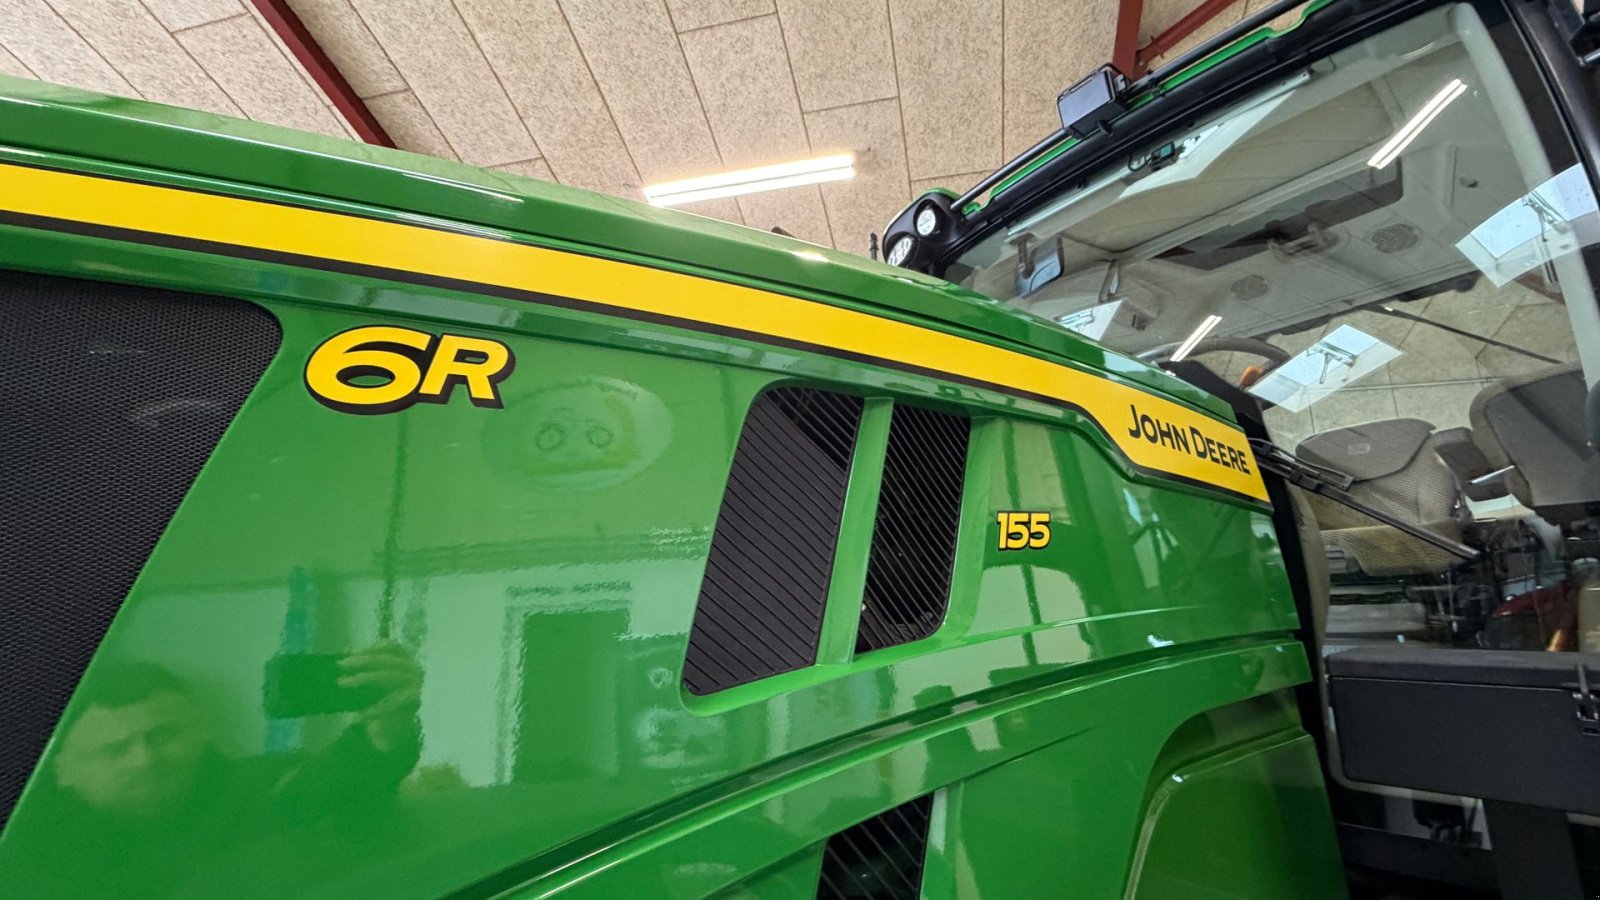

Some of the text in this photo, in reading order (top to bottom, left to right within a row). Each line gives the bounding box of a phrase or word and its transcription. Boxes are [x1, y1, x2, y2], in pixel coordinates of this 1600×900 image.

[304, 325, 515, 414] 6R
[1128, 404, 1251, 475] JOHN DEERE
[997, 511, 1051, 551] 155
